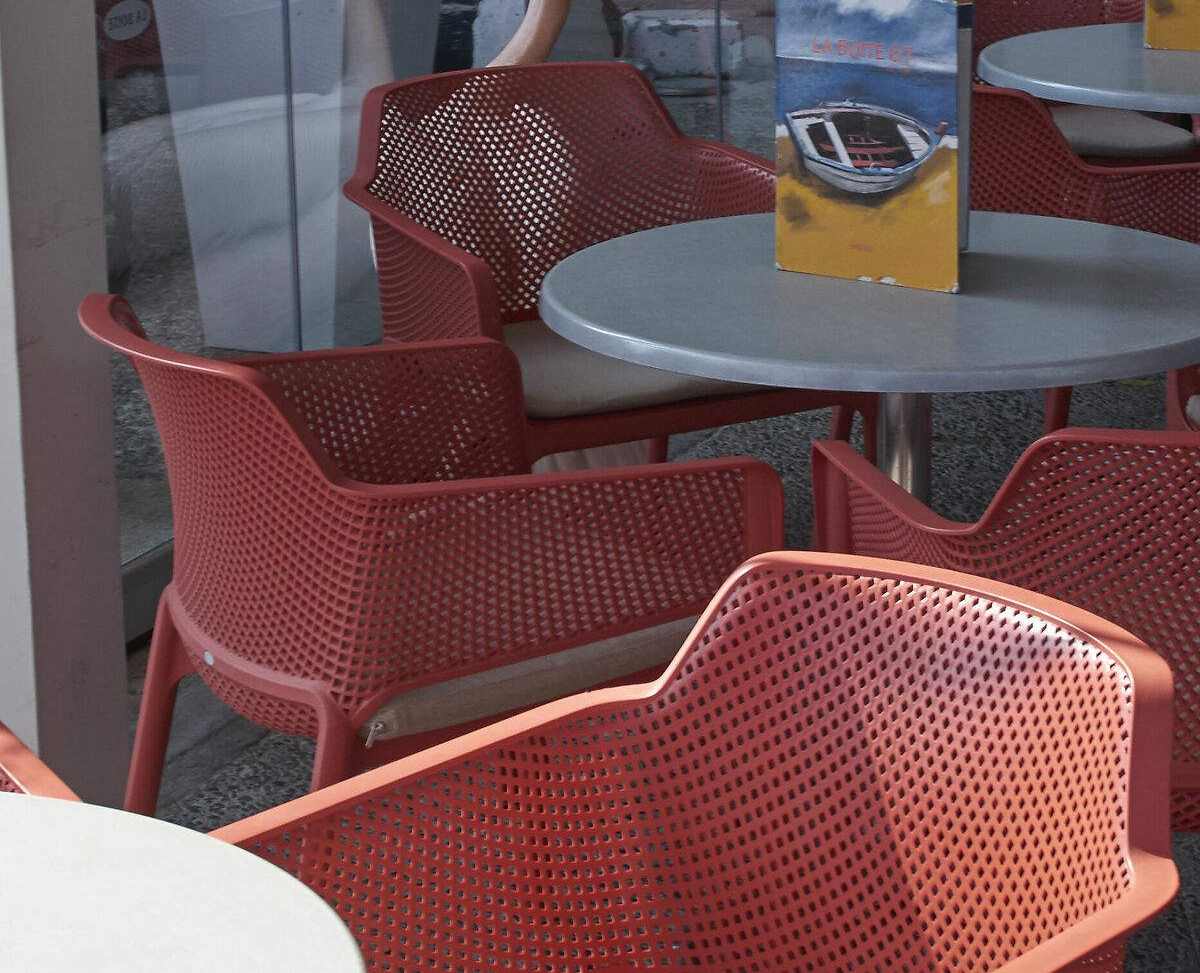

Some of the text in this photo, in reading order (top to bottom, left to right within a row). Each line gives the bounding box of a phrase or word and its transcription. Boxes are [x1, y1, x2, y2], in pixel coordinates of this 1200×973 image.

[812, 36, 915, 64] LA BOITE 67
